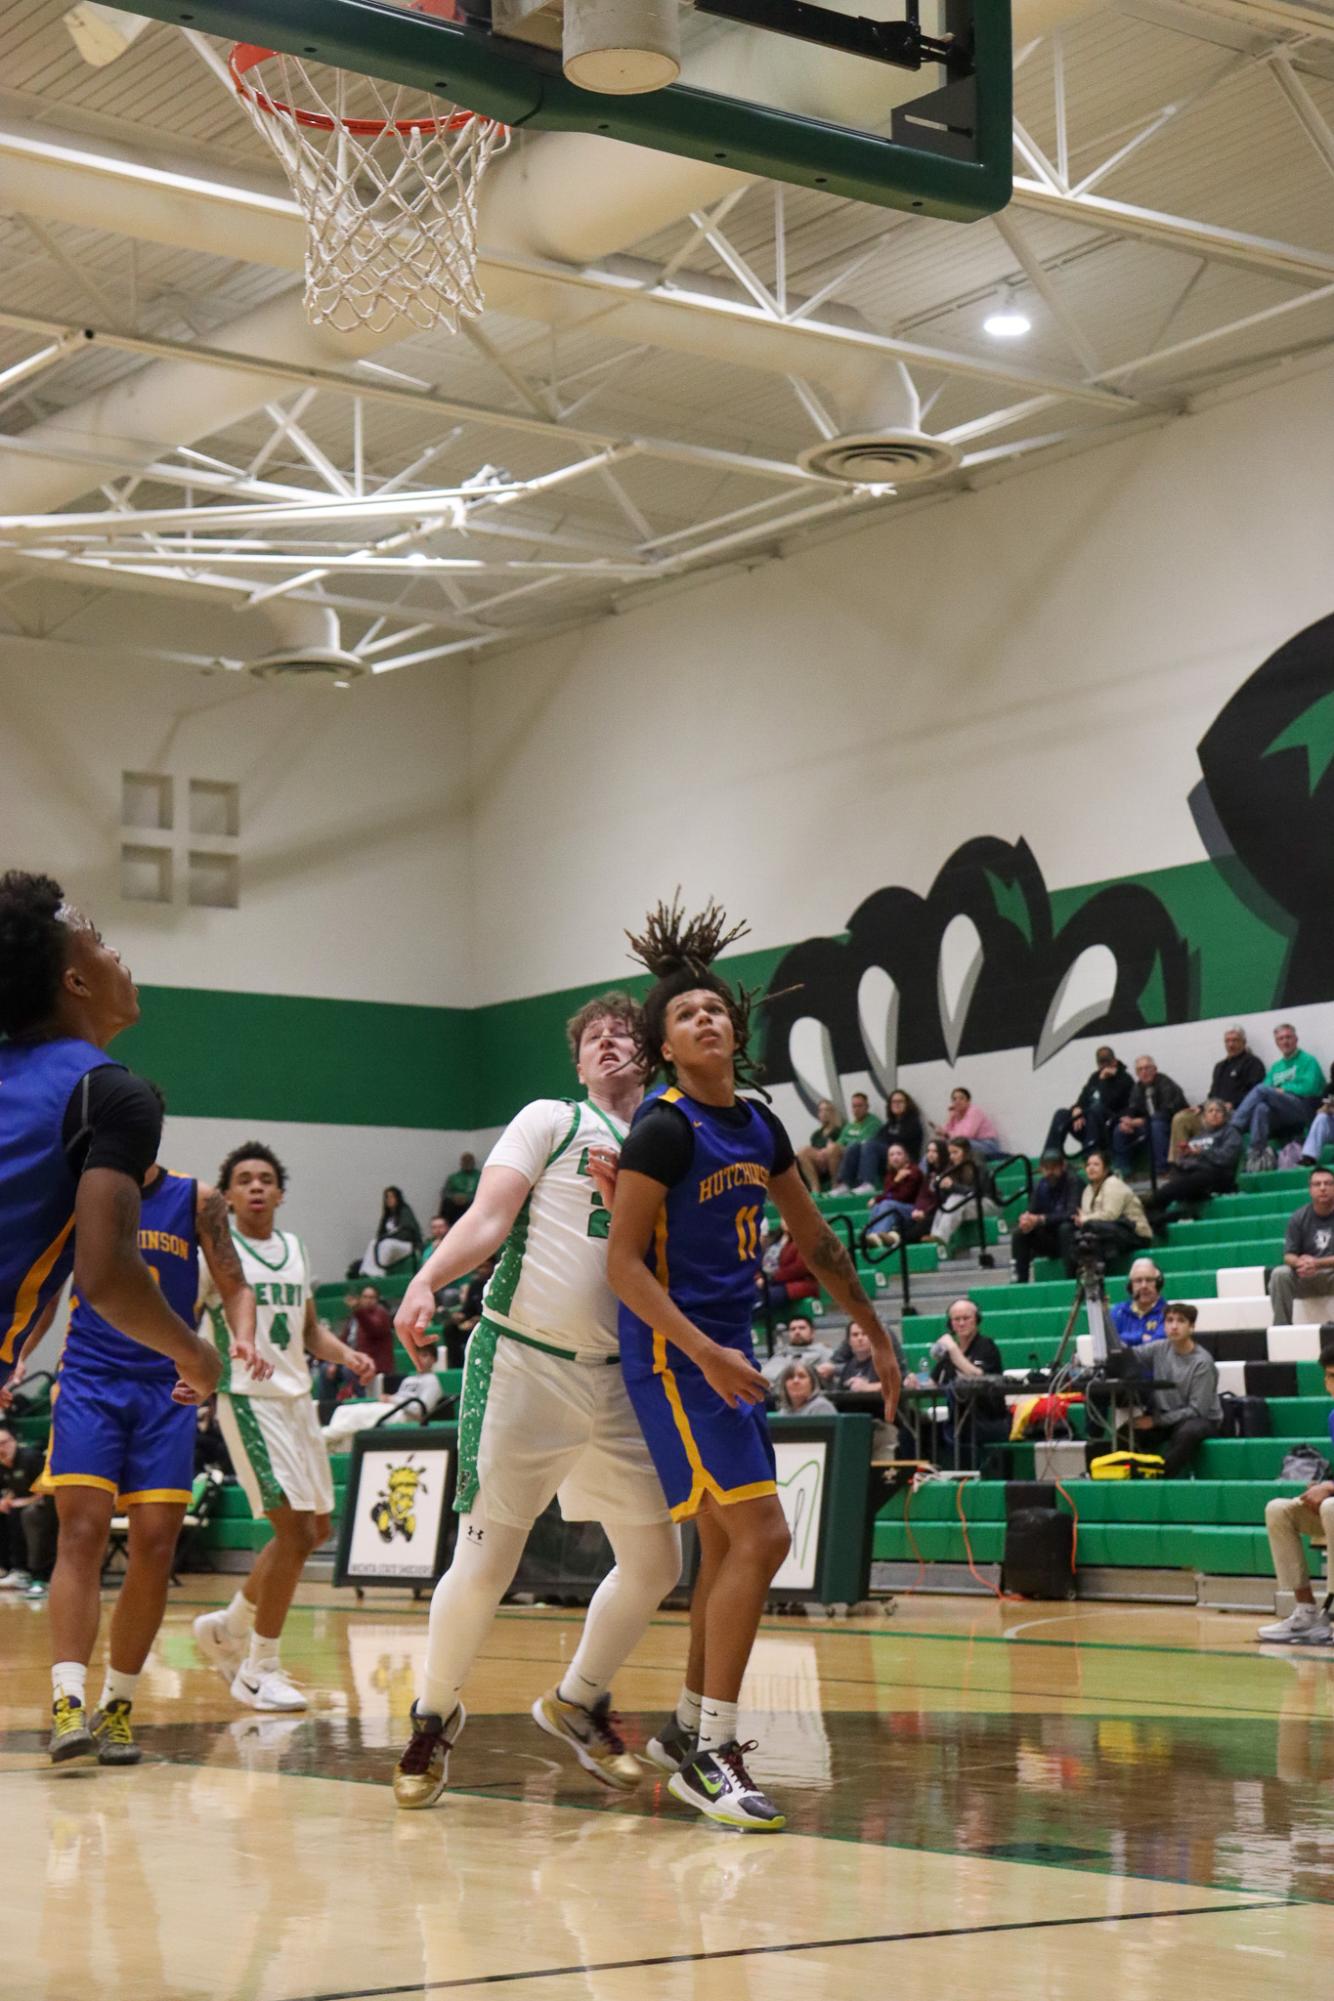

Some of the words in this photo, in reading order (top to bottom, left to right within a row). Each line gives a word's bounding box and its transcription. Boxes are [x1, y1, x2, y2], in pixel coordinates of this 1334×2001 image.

[699, 1162, 769, 1203] HUTCHINS
[137, 1230, 189, 1261] INSON
[735, 1205, 758, 1261] 11
[269, 1312, 291, 1351] 4
